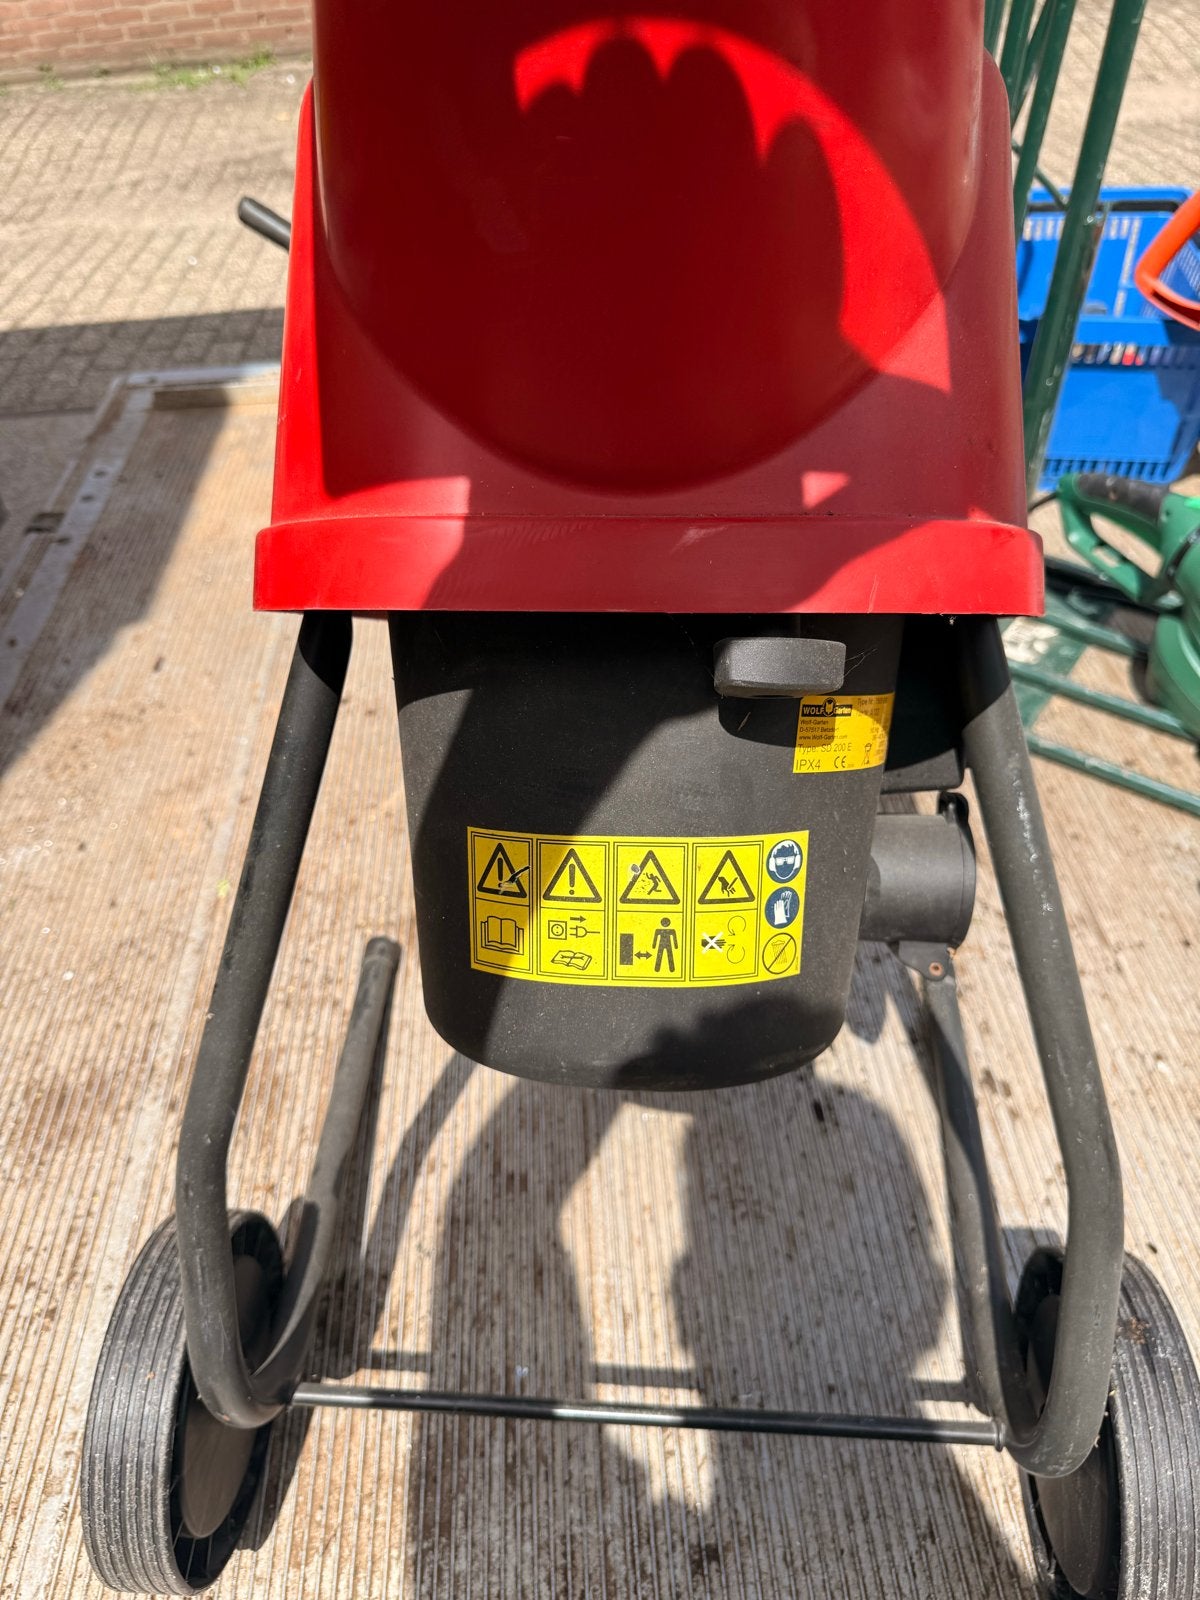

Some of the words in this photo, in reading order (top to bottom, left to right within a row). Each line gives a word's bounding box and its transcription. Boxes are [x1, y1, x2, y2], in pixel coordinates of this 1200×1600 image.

[803, 707, 824, 715] WOLF
[833, 706, 851, 715] Garten
[798, 743, 818, 755] Type:
[834, 743, 846, 752] 200
[847, 743, 852, 751] E
[796, 759, 821, 771] IPX4
